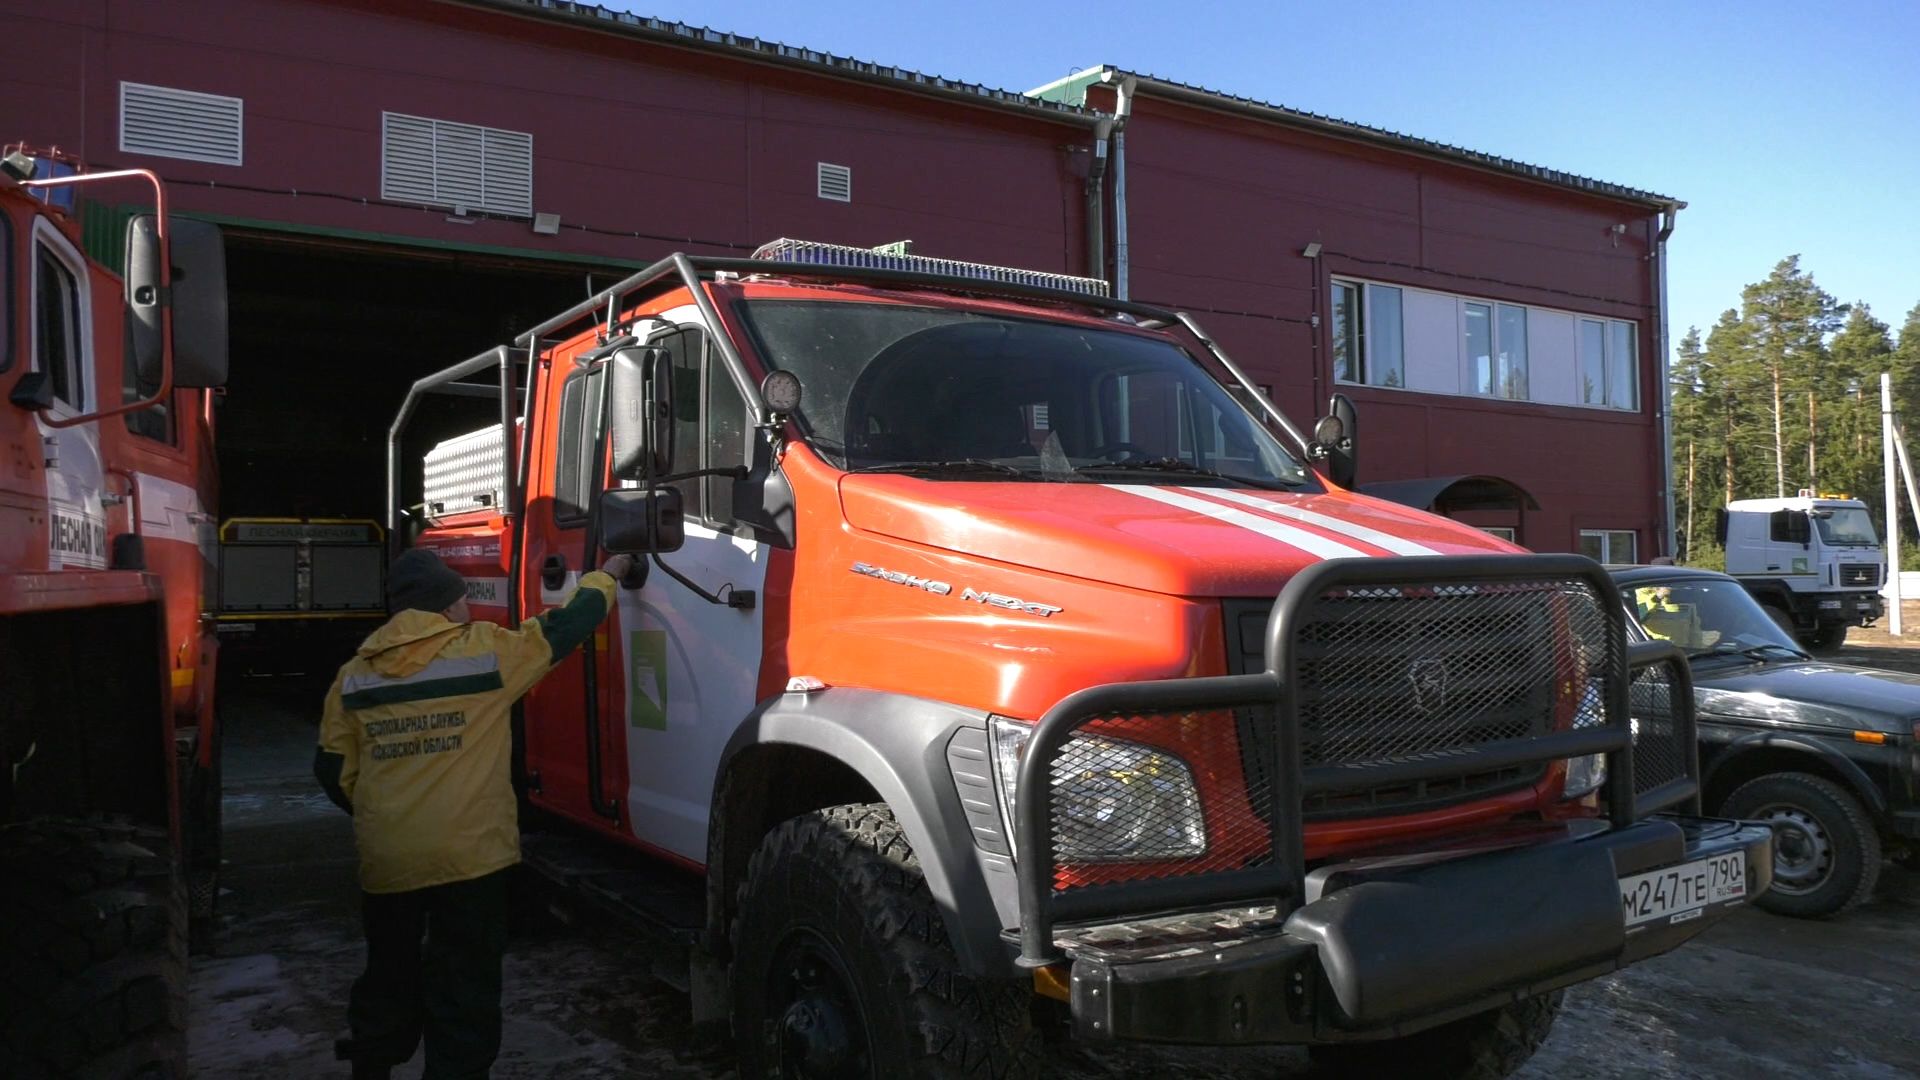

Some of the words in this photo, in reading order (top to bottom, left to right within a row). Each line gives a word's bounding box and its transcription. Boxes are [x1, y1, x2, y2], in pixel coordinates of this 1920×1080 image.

[51, 514, 92, 554] ЛЕСНАЯ
[248, 527, 304, 537] ЛЕСНАЯ
[960, 587, 1064, 617] NEXT
[430, 711, 467, 729] СЛУЖБА
[423, 734, 464, 754] ОБЛАСТИ
[1709, 856, 1741, 887] 790
[1716, 885, 1732, 897] RUS
